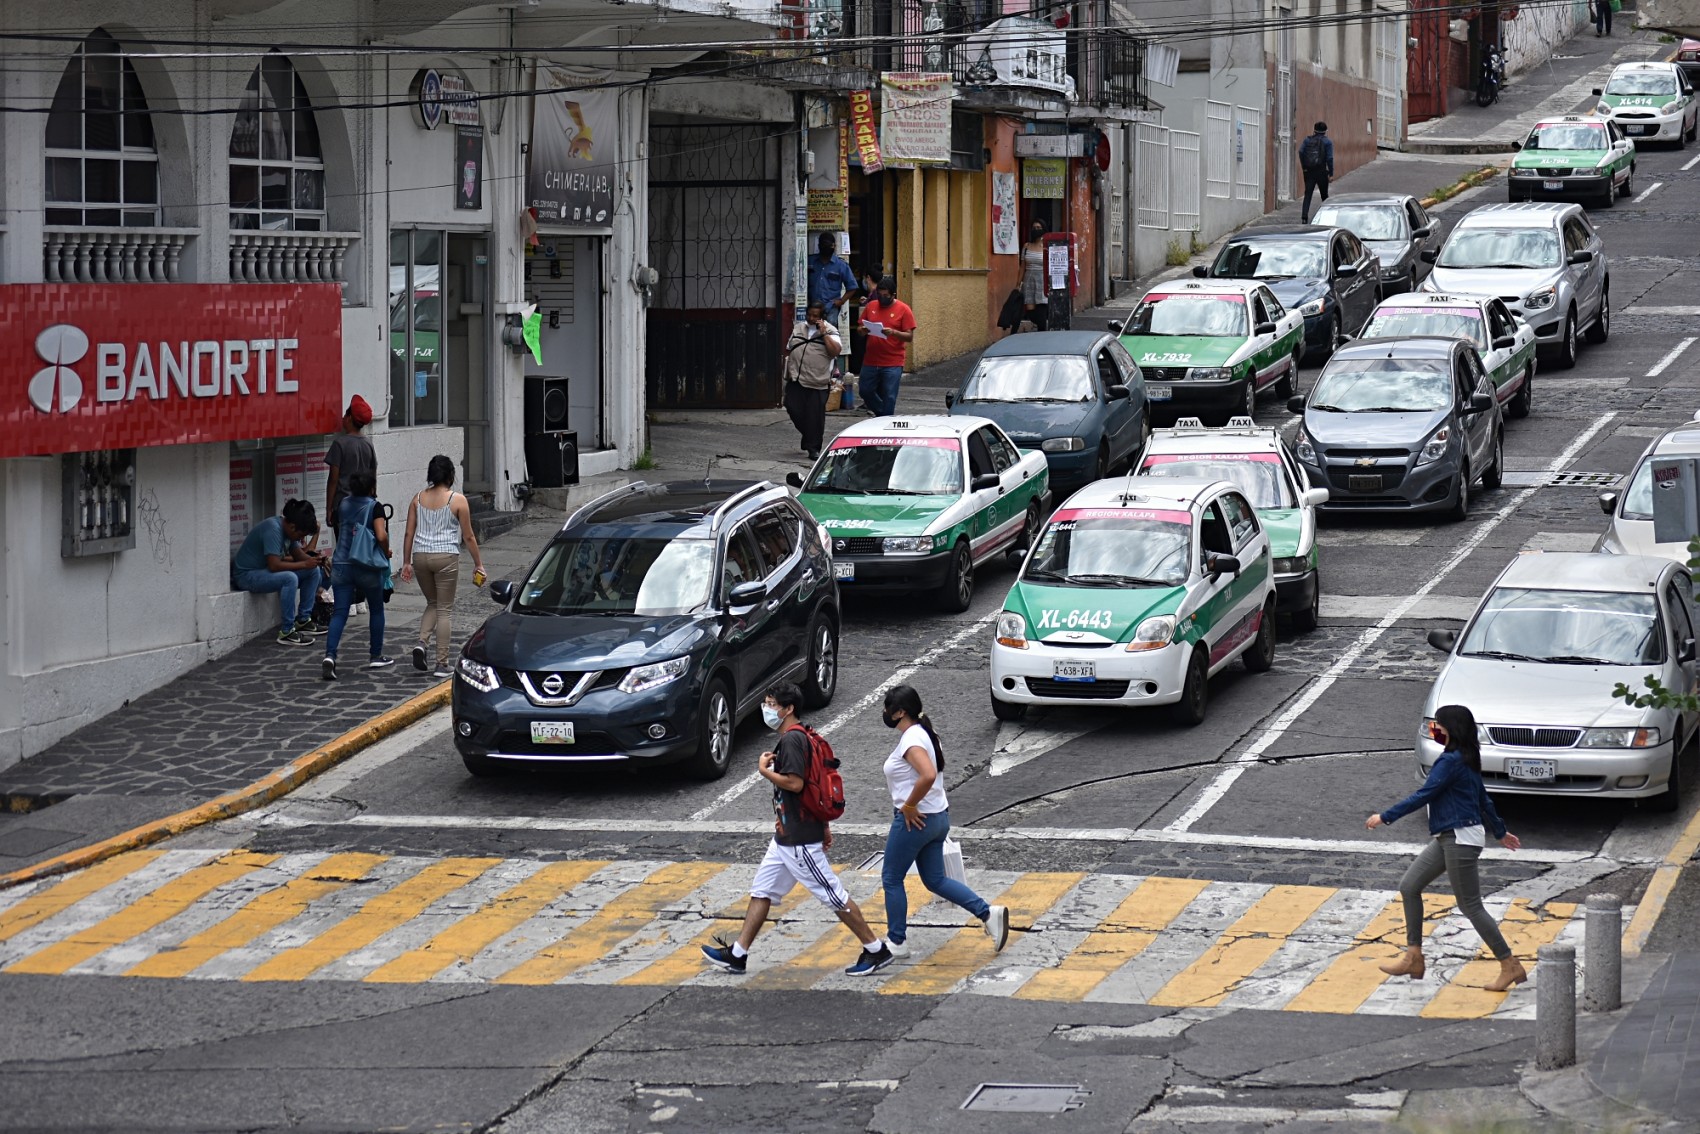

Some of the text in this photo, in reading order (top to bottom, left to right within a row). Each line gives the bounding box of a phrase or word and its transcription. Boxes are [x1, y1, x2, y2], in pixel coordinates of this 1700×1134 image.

[887, 98, 947, 110] DOLARES
[893, 110, 942, 121] EUROS
[851, 93, 879, 166] DOLARES
[544, 170, 590, 192] CHIMERA
[1025, 176, 1064, 185] INTERNET
[1025, 187, 1064, 197] COPIAS
[1140, 352, 1192, 362] XL-7932
[97, 338, 299, 402] BANORTE
[1231, 418, 1251, 426] TAXI
[896, 438, 928, 446] XALAPA
[1121, 511, 1156, 519] XALAPA
[823, 519, 875, 529] XL-3547
[1050, 523, 1077, 532] XL-6443
[1037, 609, 1113, 629] XL-6443
[1055, 666, 1094, 676] A-638-XFA
[1510, 765, 1554, 777] XZL-489-A
